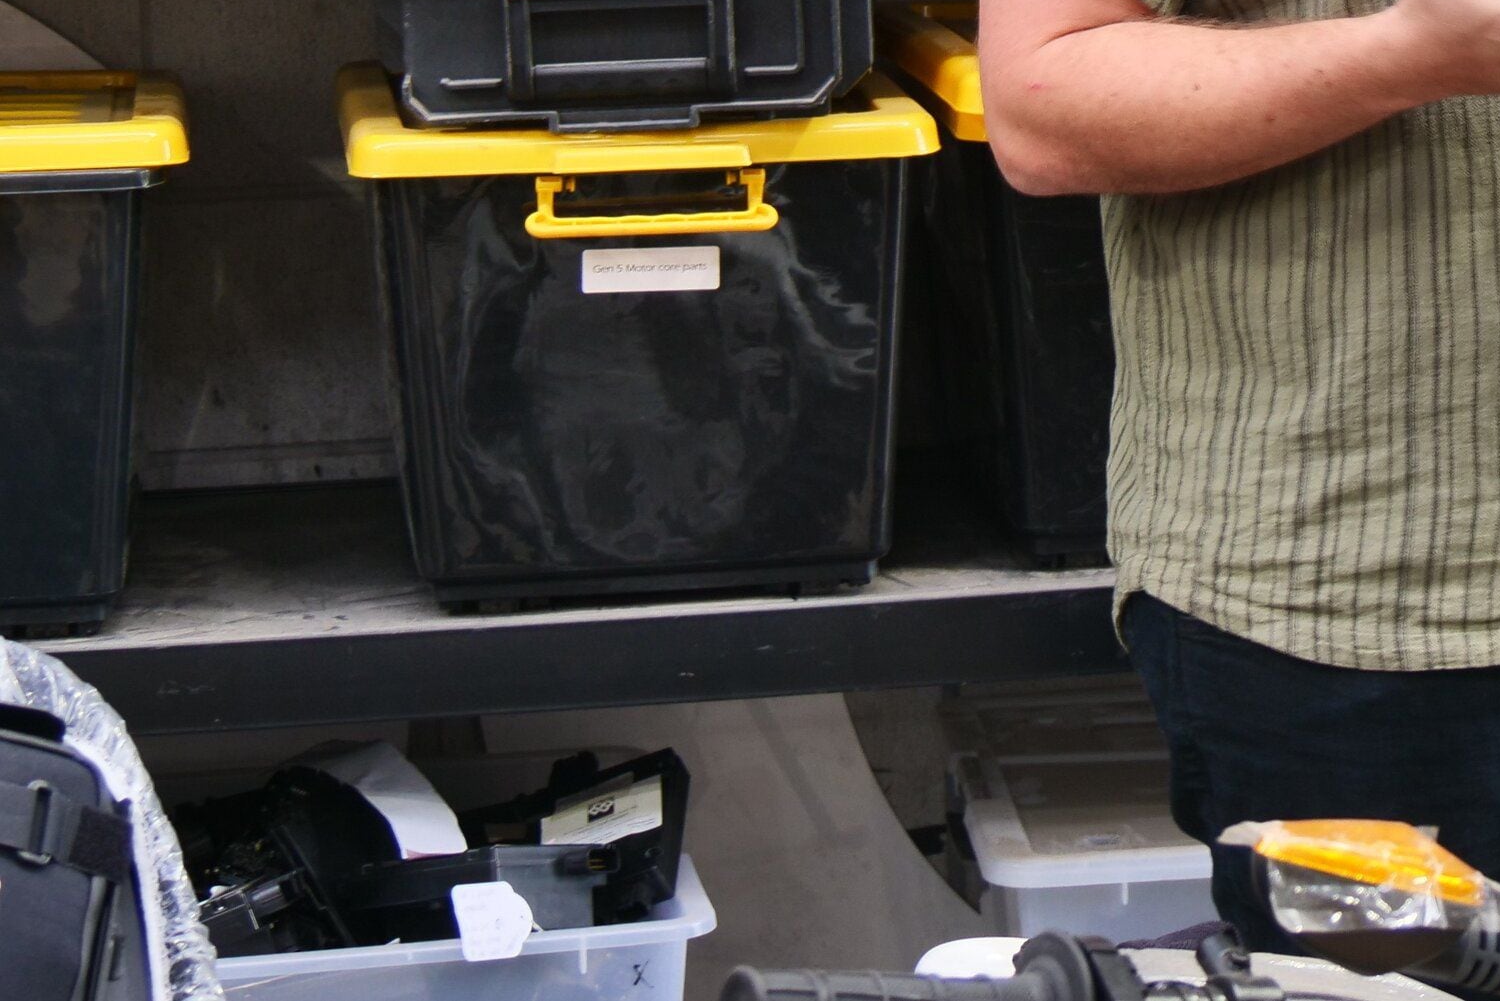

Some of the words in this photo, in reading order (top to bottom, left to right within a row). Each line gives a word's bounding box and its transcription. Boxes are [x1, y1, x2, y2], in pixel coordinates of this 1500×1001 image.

[593, 264, 614, 273] Gen
[625, 263, 656, 273] Motor
[682, 262, 708, 273] parts
